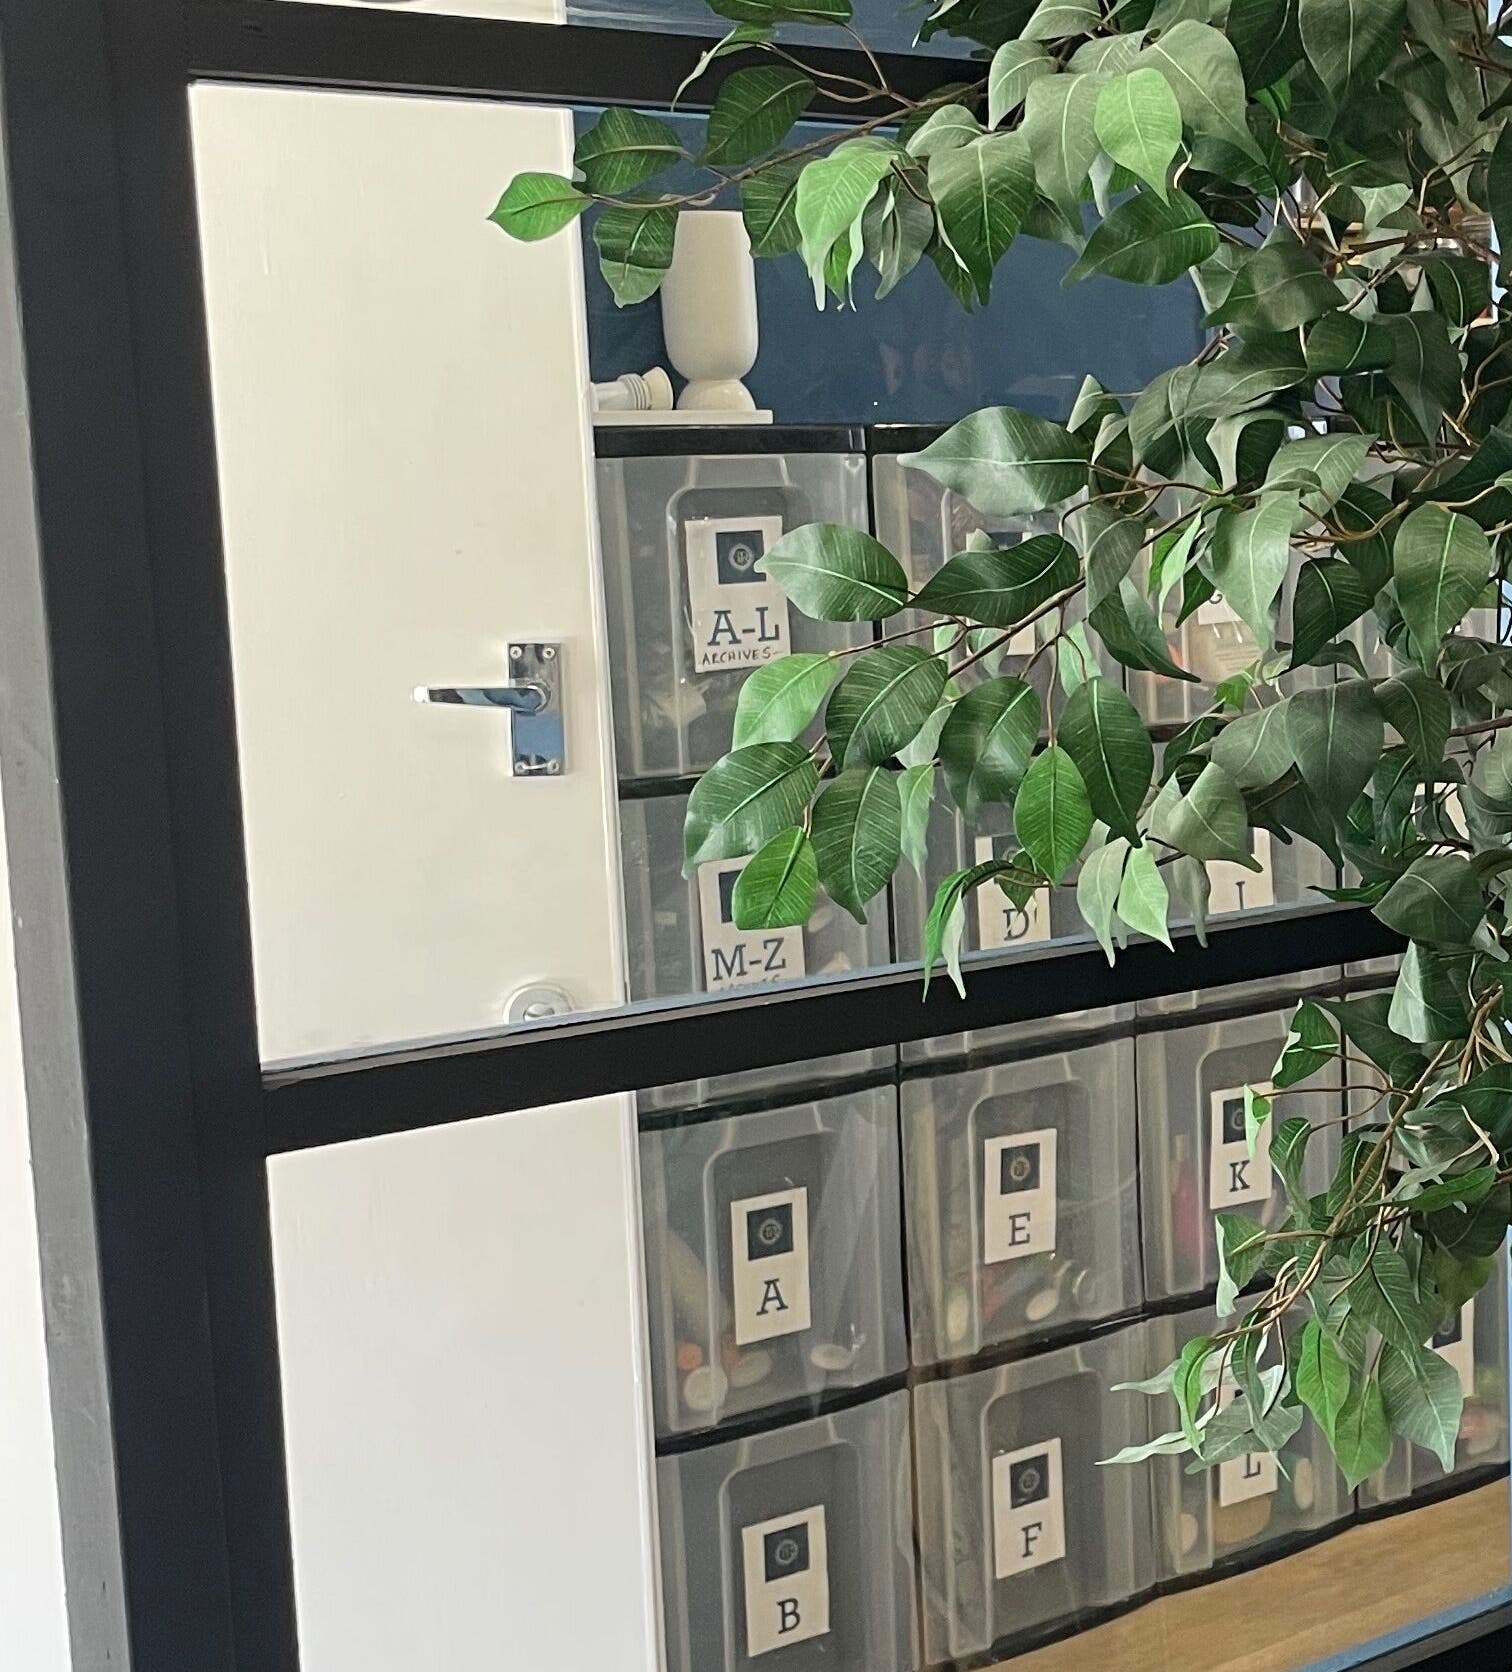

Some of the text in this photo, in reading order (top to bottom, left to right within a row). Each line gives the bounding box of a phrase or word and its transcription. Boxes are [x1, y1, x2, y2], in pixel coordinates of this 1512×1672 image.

[707, 606, 780, 646] A-L
[1002, 908, 1030, 941] D
[711, 937, 787, 982] M-Z
[1229, 1159, 1251, 1193] K
[1008, 1212, 1031, 1247] E
[756, 1278, 789, 1316] A
[1021, 1521, 1043, 1558] F
[776, 1597, 801, 1635] B
